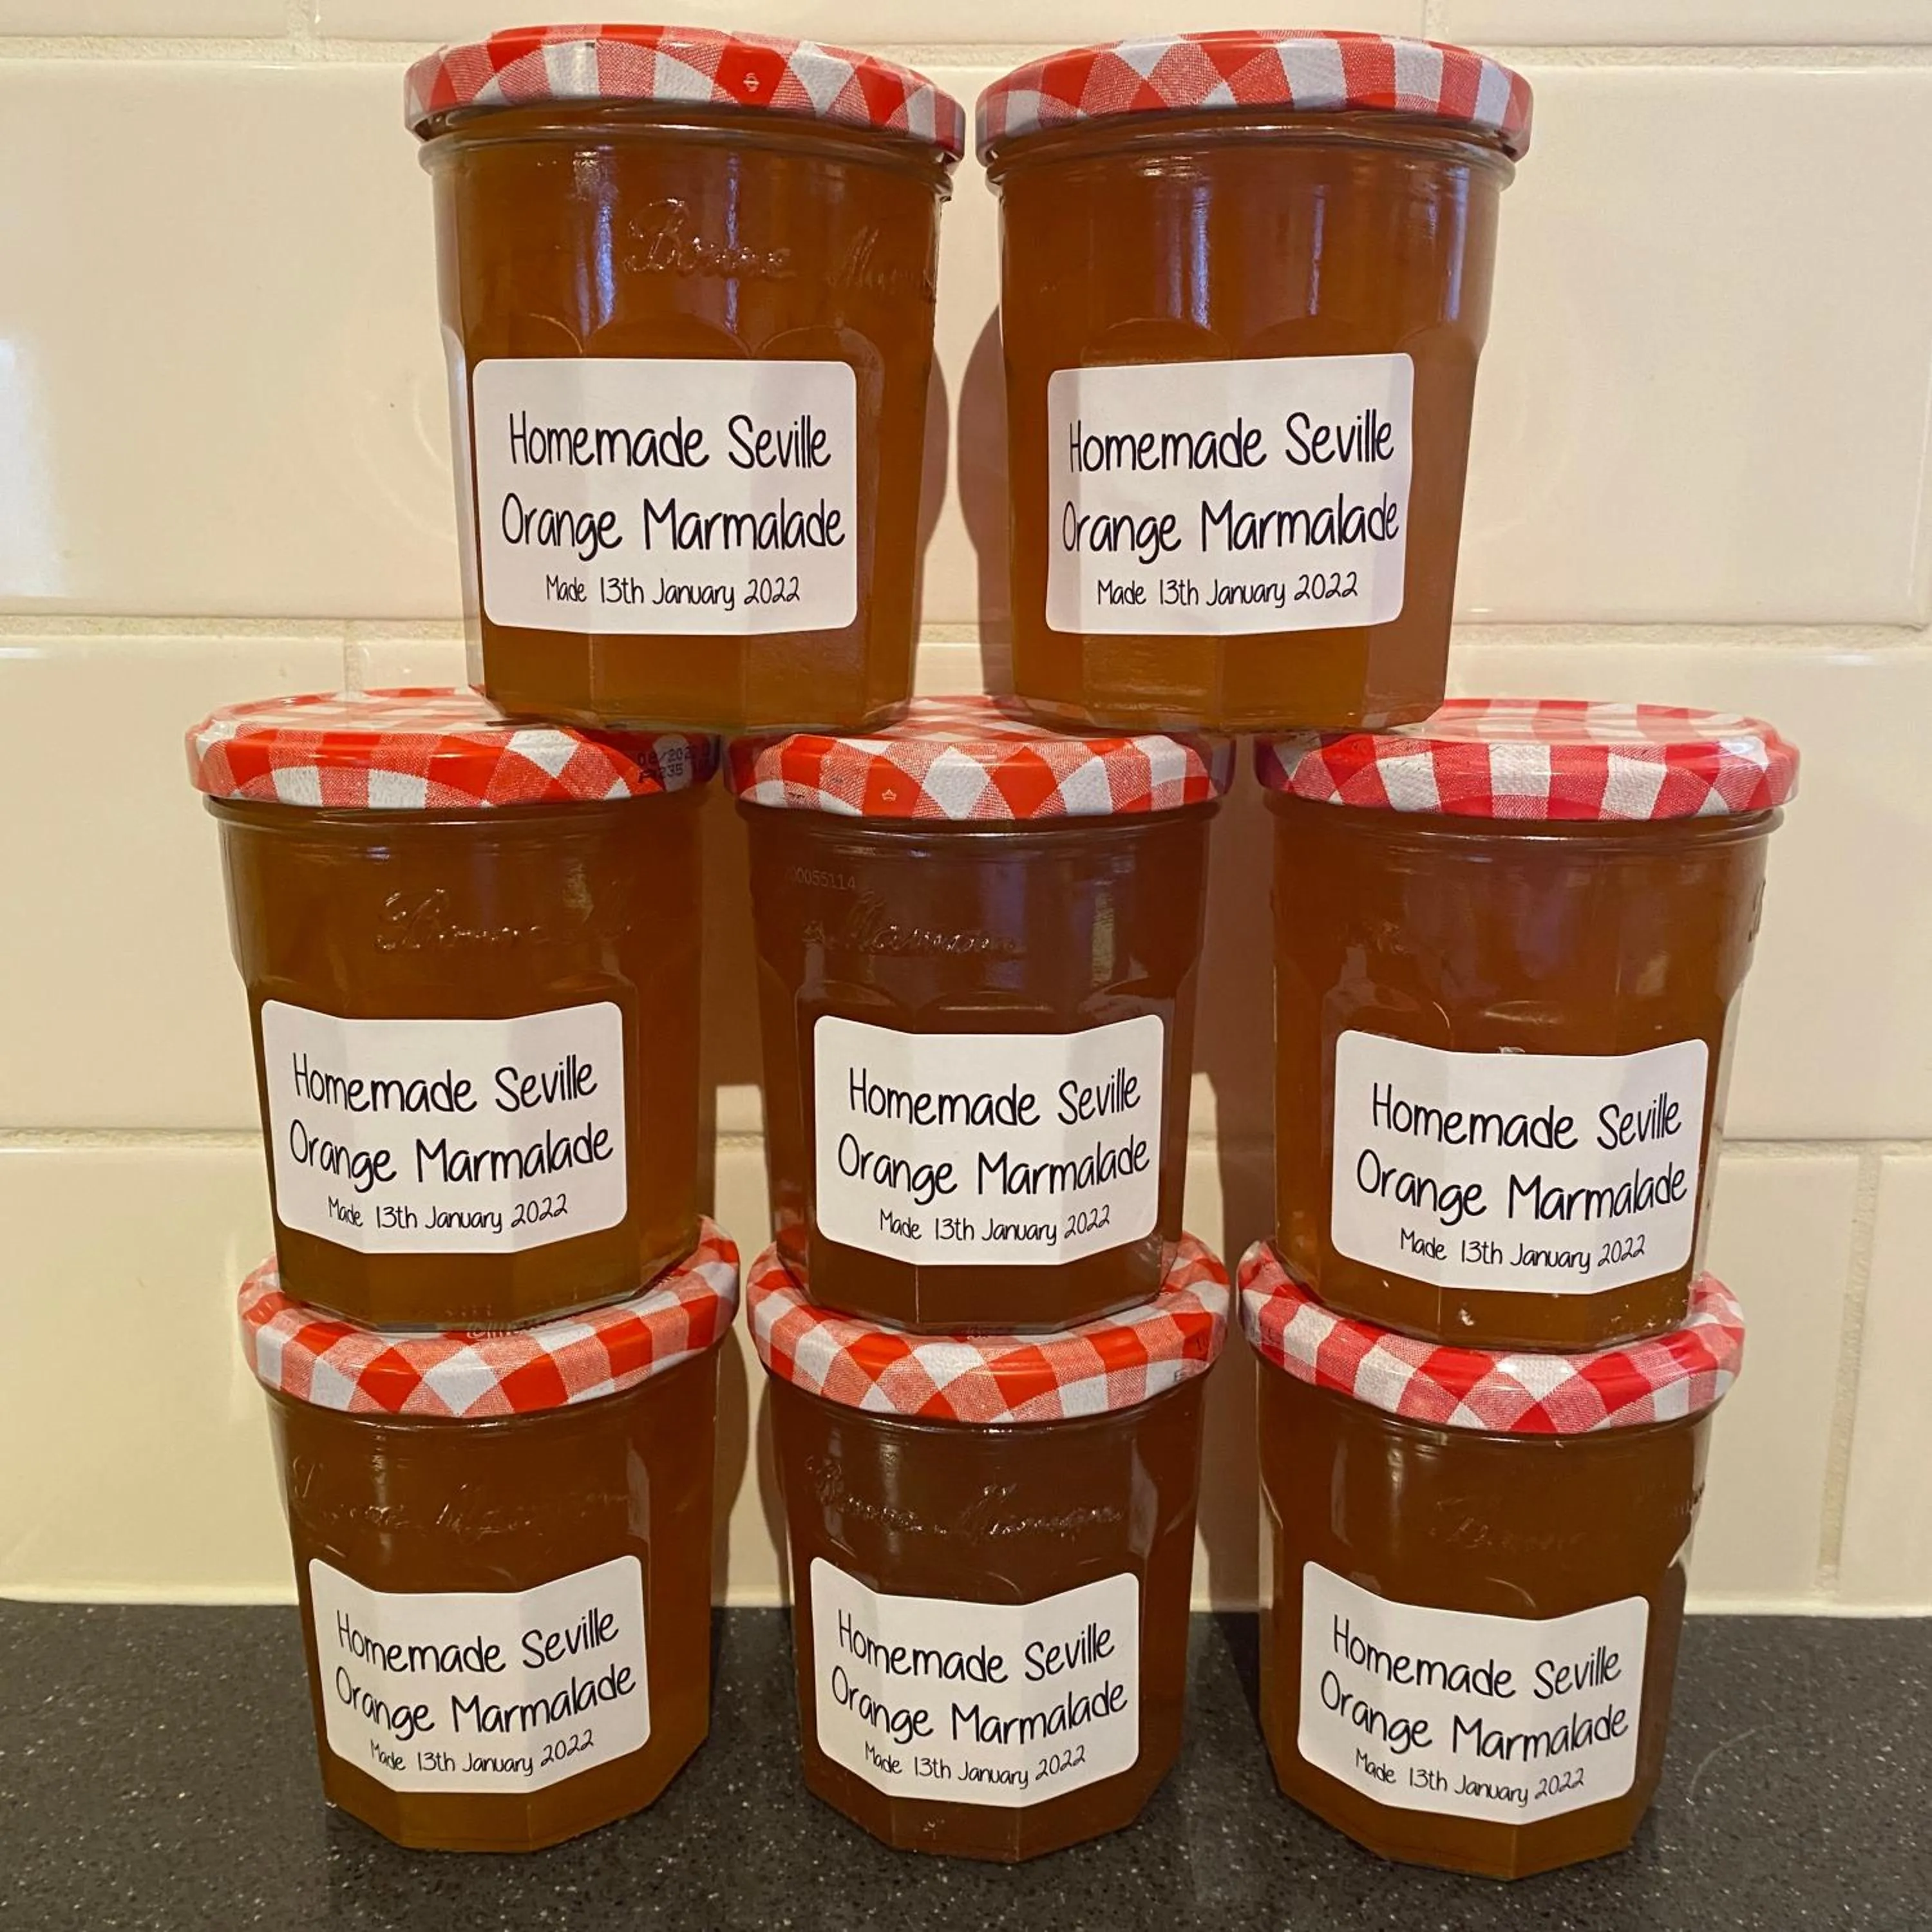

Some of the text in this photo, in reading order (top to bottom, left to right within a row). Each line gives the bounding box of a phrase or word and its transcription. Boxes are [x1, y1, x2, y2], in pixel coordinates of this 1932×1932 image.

[509, 410, 831, 469] Homemade Seville
[1070, 408, 1394, 473] Homemade Seville
[502, 492, 846, 562] Orange Marmalade
[1062, 491, 1399, 565] Orange Marmalade
[545, 574, 800, 612] Made 13th January 2022
[1097, 571, 1358, 609] Made 13th January 2022
[292, 1052, 598, 1113] Homemade Seville
[849, 1066, 1141, 1126] Homemade Seville
[1372, 1082, 1682, 1151] Homemade Seville
[289, 1119, 614, 1193] Orange Marmalade
[838, 1133, 1150, 1206] Orange Marmalade
[1356, 1148, 1688, 1227] Orange Marmalade
[328, 1193, 568, 1235] Made 13th January 2022
[880, 1204, 1110, 1247] Made 13th January 2022
[1400, 1227, 1645, 1274] Made 13th January 2022
[337, 1607, 620, 1673] Homemade Seville
[838, 1609, 1115, 1684] Homemade Seville
[1334, 1614, 1622, 1700] Homemade Seville
[336, 1663, 637, 1741] Orange Marmalade
[831, 1665, 1128, 1745] Orange Marmalade
[1320, 1670, 1629, 1763] Orange Marmalade
[370, 1728, 594, 1777] Made 13th January 2022
[865, 1741, 1086, 1790] Made 13th January 2022
[1356, 1747, 1584, 1808] Made 13th January 2022
